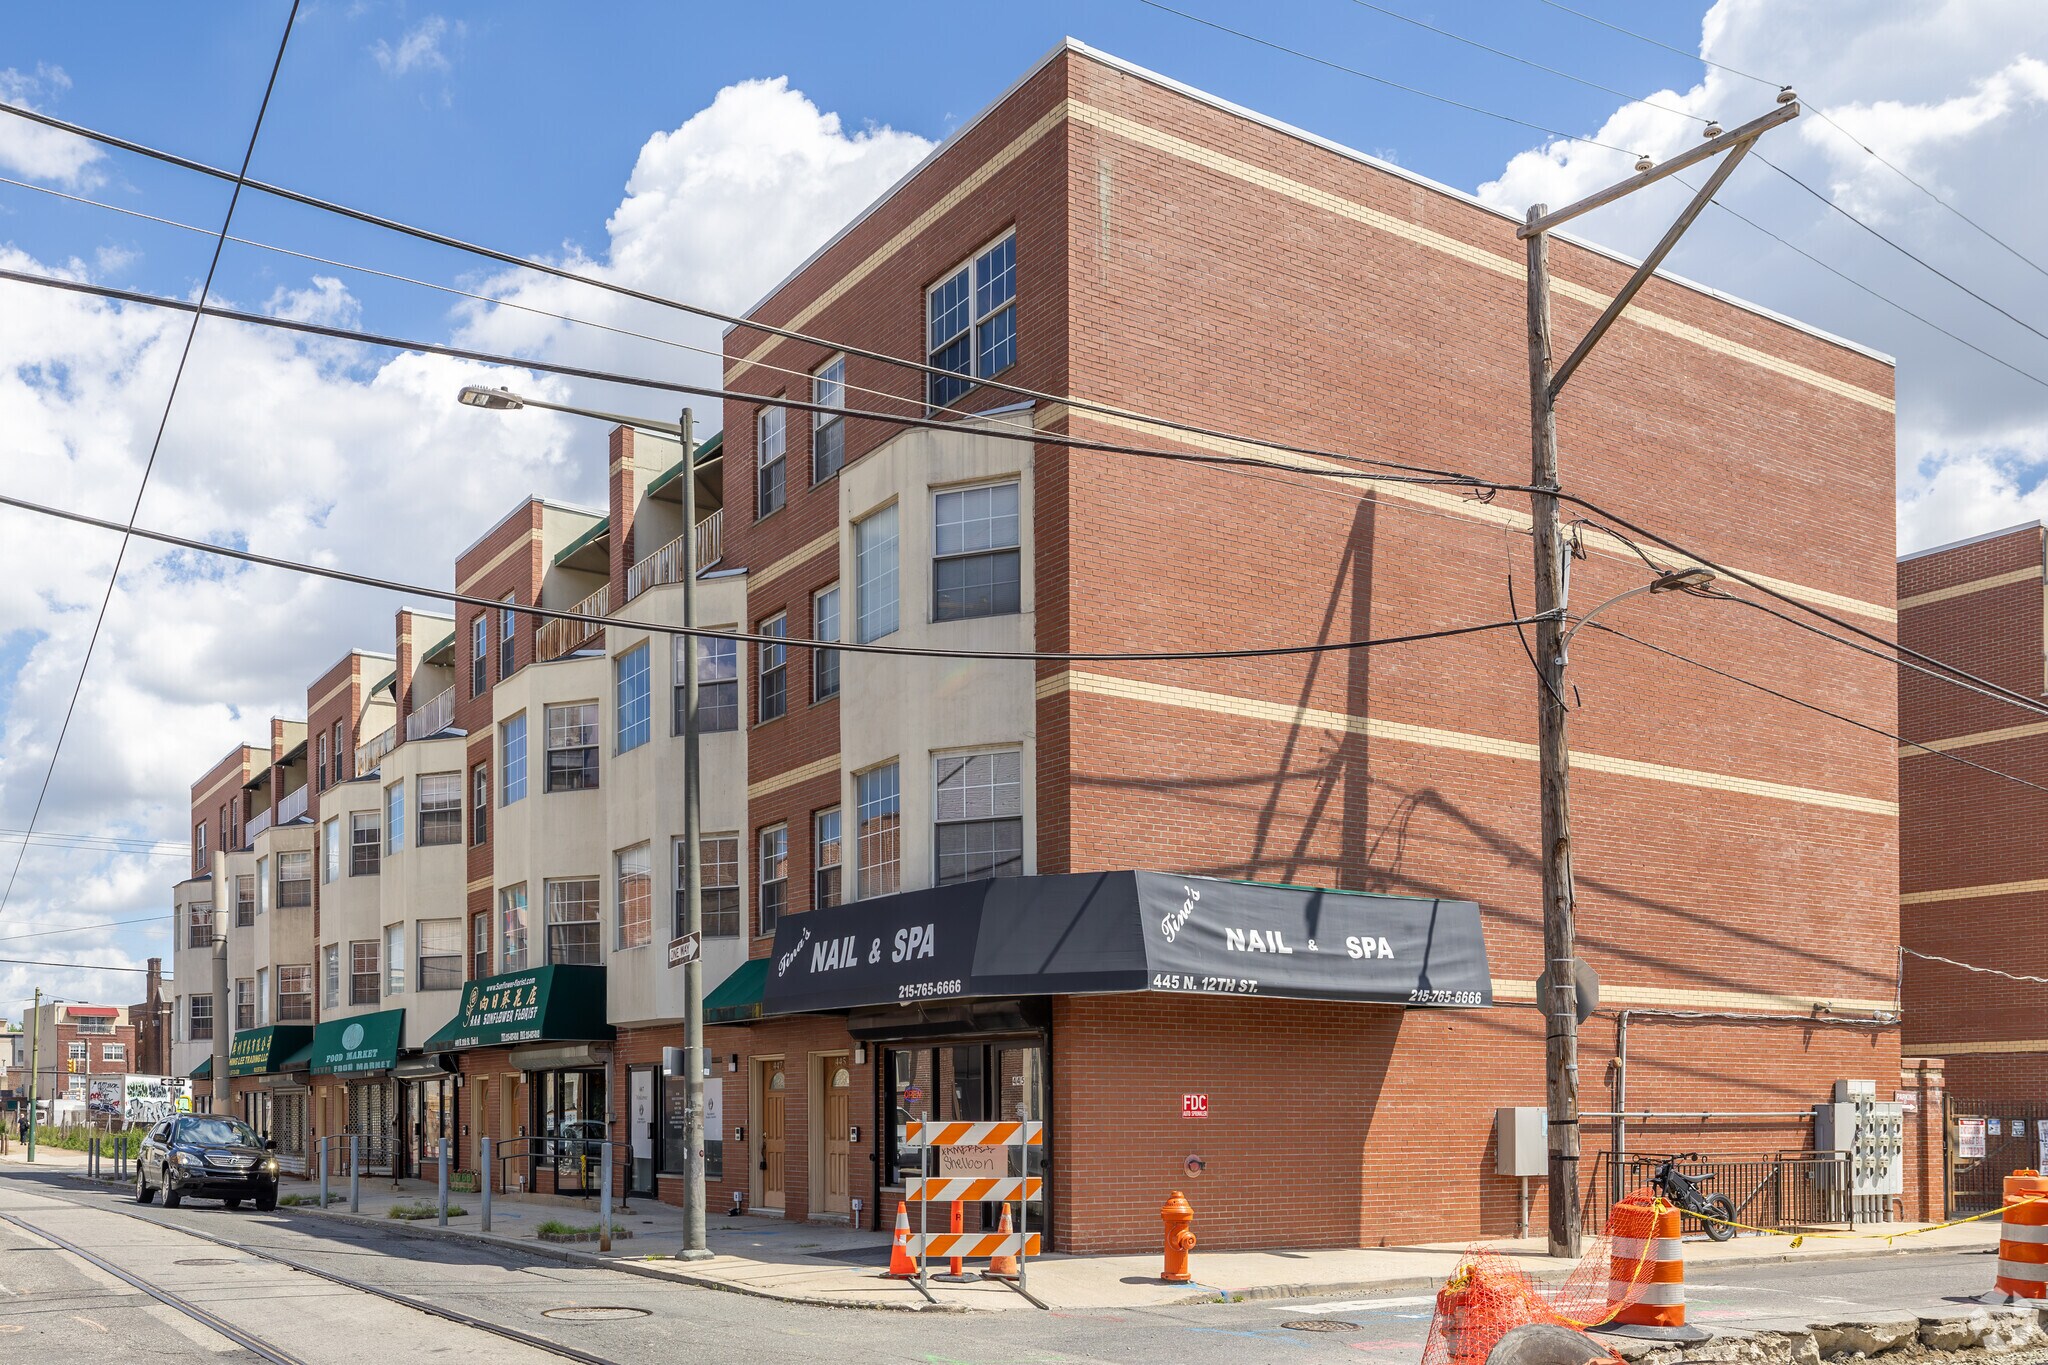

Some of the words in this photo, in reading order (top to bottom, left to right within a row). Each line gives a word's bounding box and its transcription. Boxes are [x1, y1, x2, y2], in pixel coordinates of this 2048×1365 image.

[1161, 885, 1201, 943] Tina's
[777, 927, 812, 978] Tina's
[810, 935, 858, 973] NAIL
[868, 937, 882, 964] &
[892, 924, 935, 963] SPA
[1225, 927, 1293, 954] NAIL
[1307, 939, 1319, 952] &
[1345, 936, 1395, 960] SPA
[899, 979, 962, 998] 215-765-6666
[1153, 973, 1180, 990] 445
[1183, 975, 1197, 991] N.
[1202, 977, 1236, 992] 12TH
[1238, 979, 1258, 993] ST.
[1408, 988, 1482, 1005] 215-765-6666
[483, 1009, 514, 1026] SUNFLOWER
[514, 1006, 539, 1021] FLORIST
[325, 1053, 344, 1063] FOOD
[346, 1048, 379, 1061] MARKET
[333, 1063, 353, 1073] FOOD
[356, 1060, 391, 1071] MARKET
[1012, 1076, 1025, 1086] 445
[904, 1090, 922, 1099] OPEN
[1183, 1095, 1207, 1110] FDC
